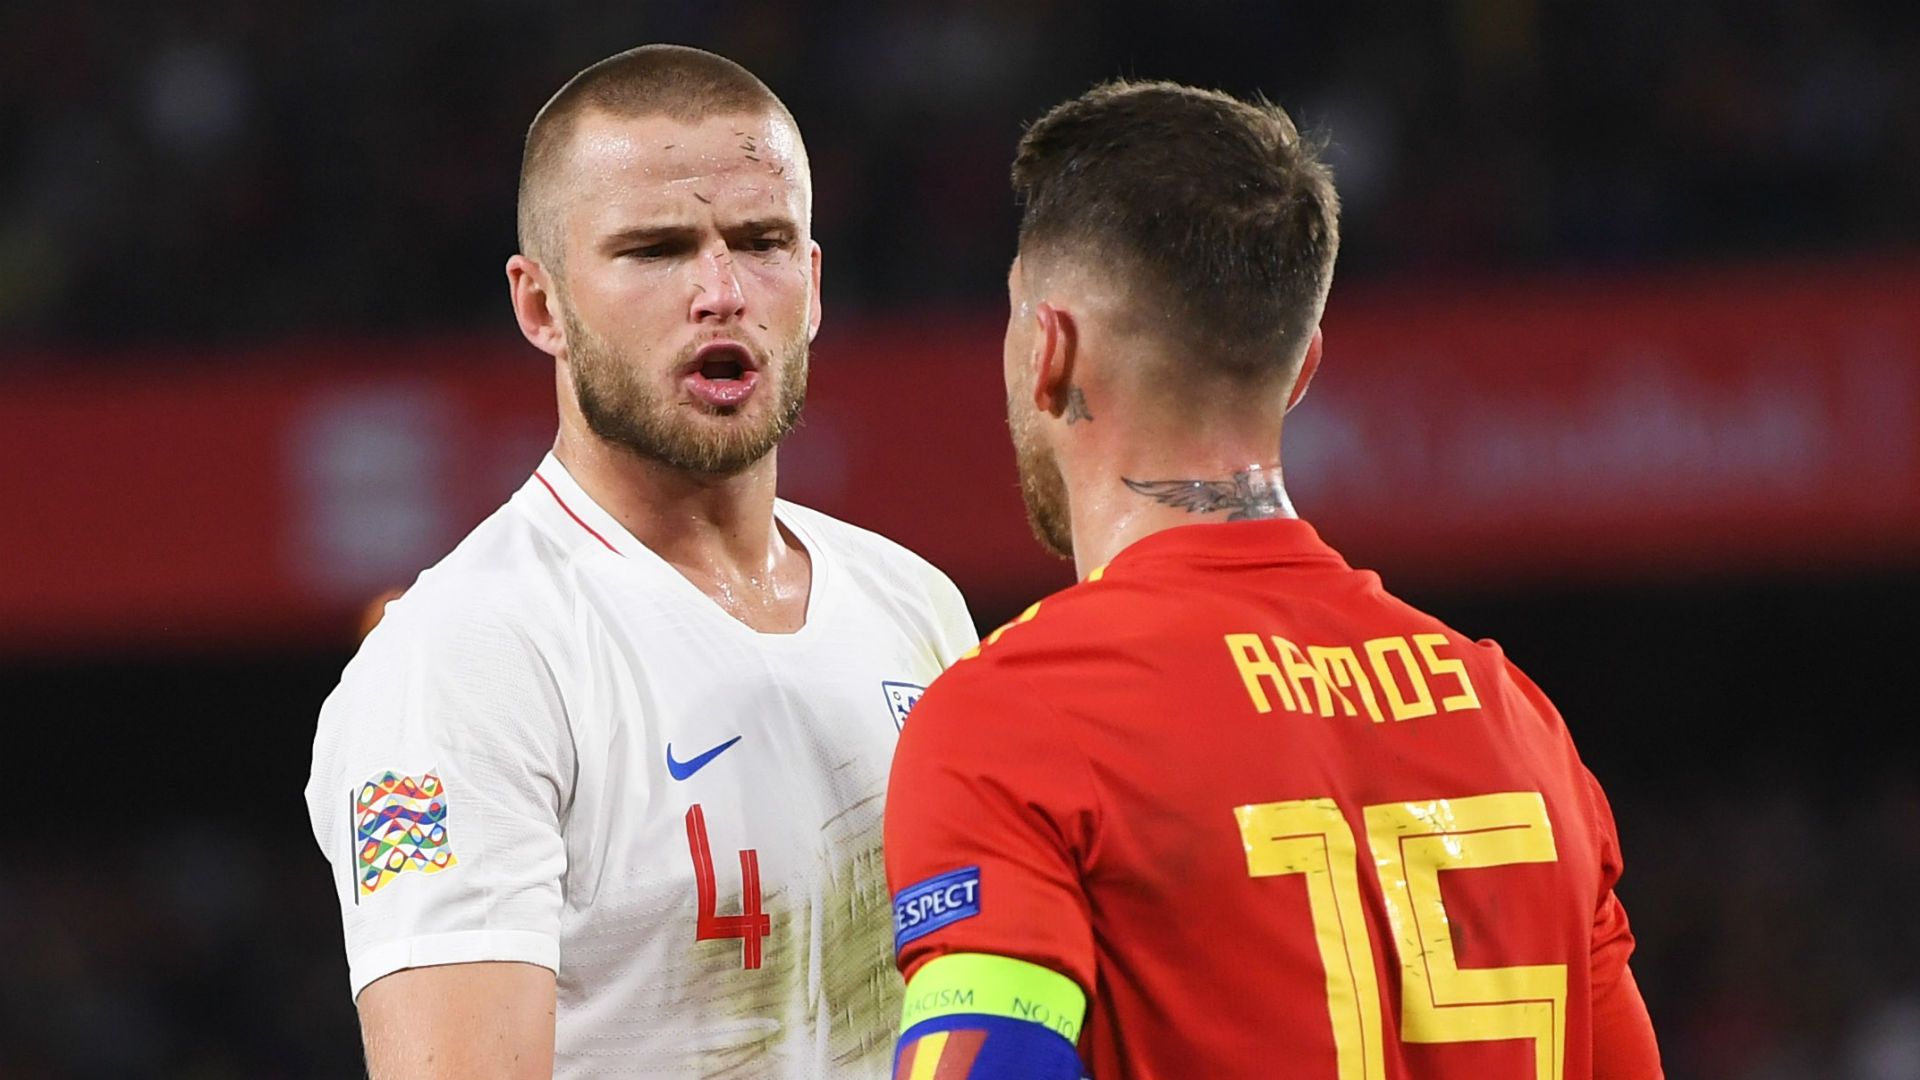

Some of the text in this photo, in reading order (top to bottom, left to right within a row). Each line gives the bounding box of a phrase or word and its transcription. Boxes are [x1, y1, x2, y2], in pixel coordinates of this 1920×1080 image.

[1224, 633, 1482, 723] RAMOS
[685, 803, 770, 970] 4
[897, 879, 978, 930] ESPECT
[1233, 792, 1568, 1080] 15
[1012, 997, 1050, 1025] NO
